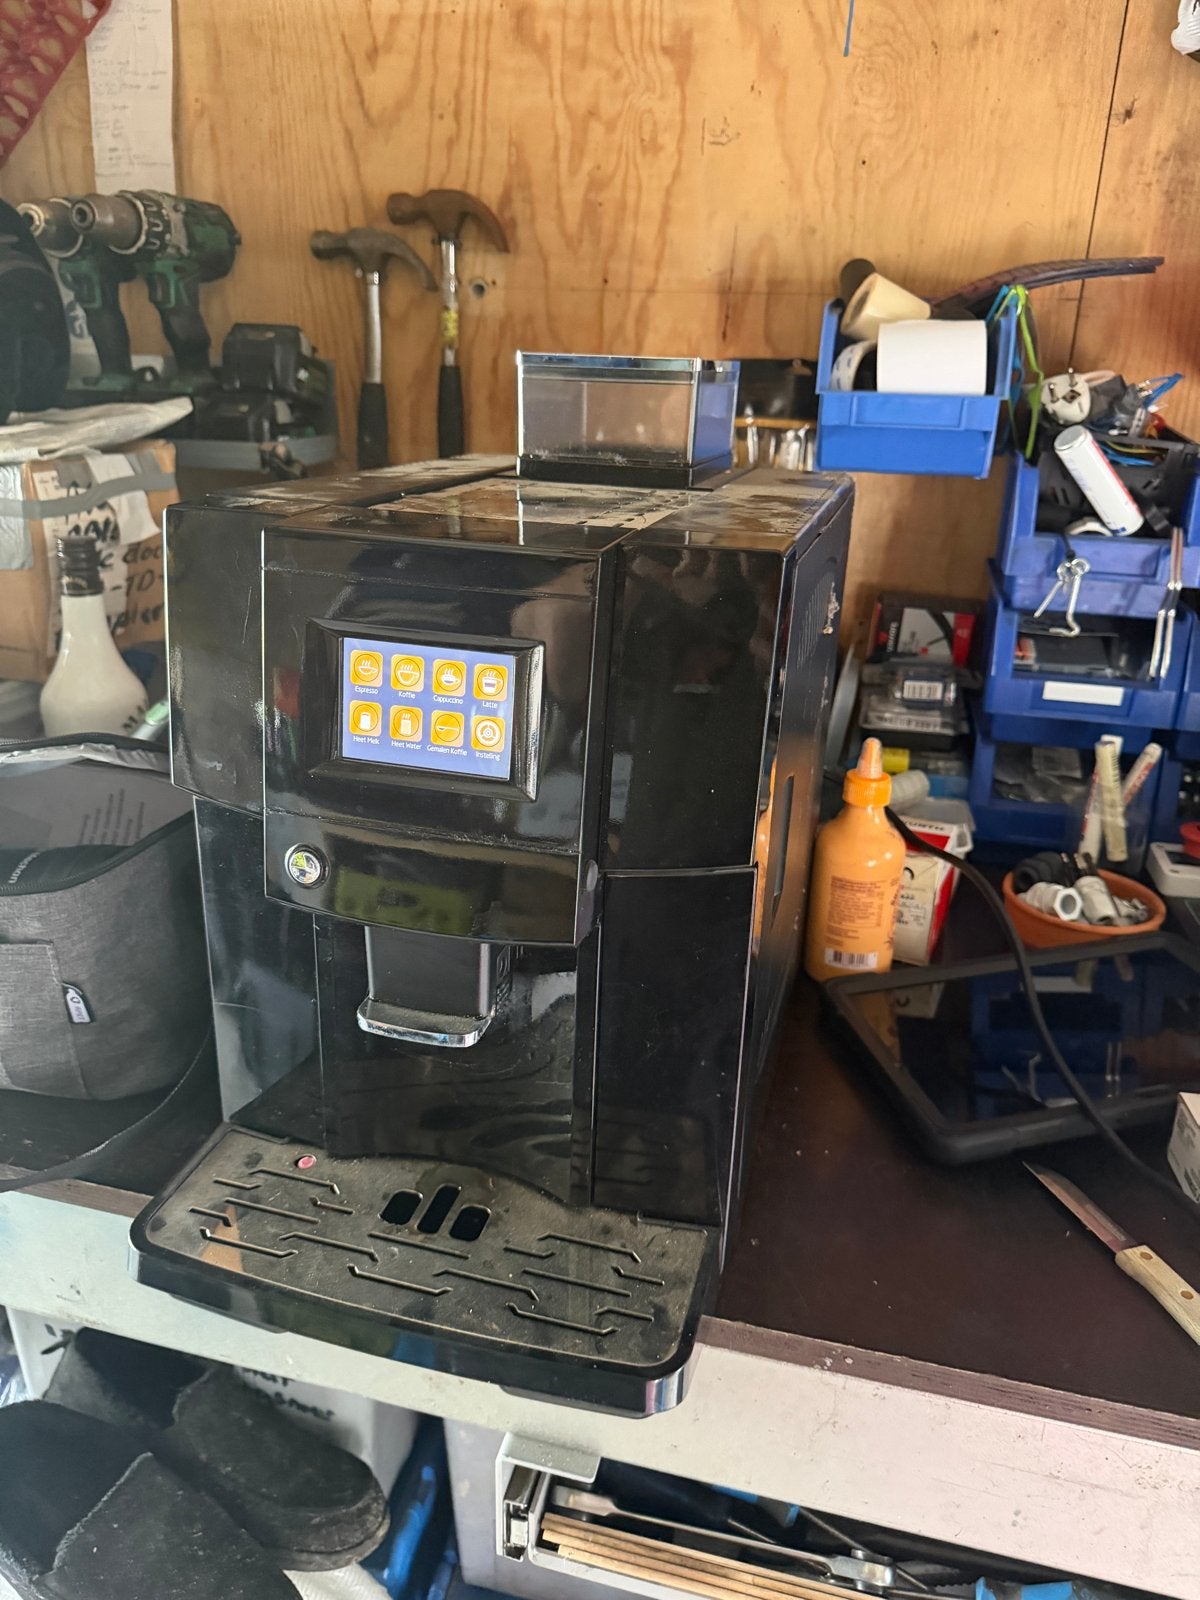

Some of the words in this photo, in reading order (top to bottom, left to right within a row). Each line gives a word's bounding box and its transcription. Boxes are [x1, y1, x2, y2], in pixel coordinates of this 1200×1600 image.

[354, 685, 379, 695] Espresso
[398, 691, 416, 699] Koffie
[433, 694, 464, 705] Cappuccino
[482, 700, 498, 709] Latte
[352, 735, 366, 744] Heet
[367, 736, 380, 745] Melk
[391, 740, 405, 749] Heet
[405, 742, 422, 750] Water
[426, 744, 450, 754] Gemalen
[450, 747, 468, 756] Koffie
